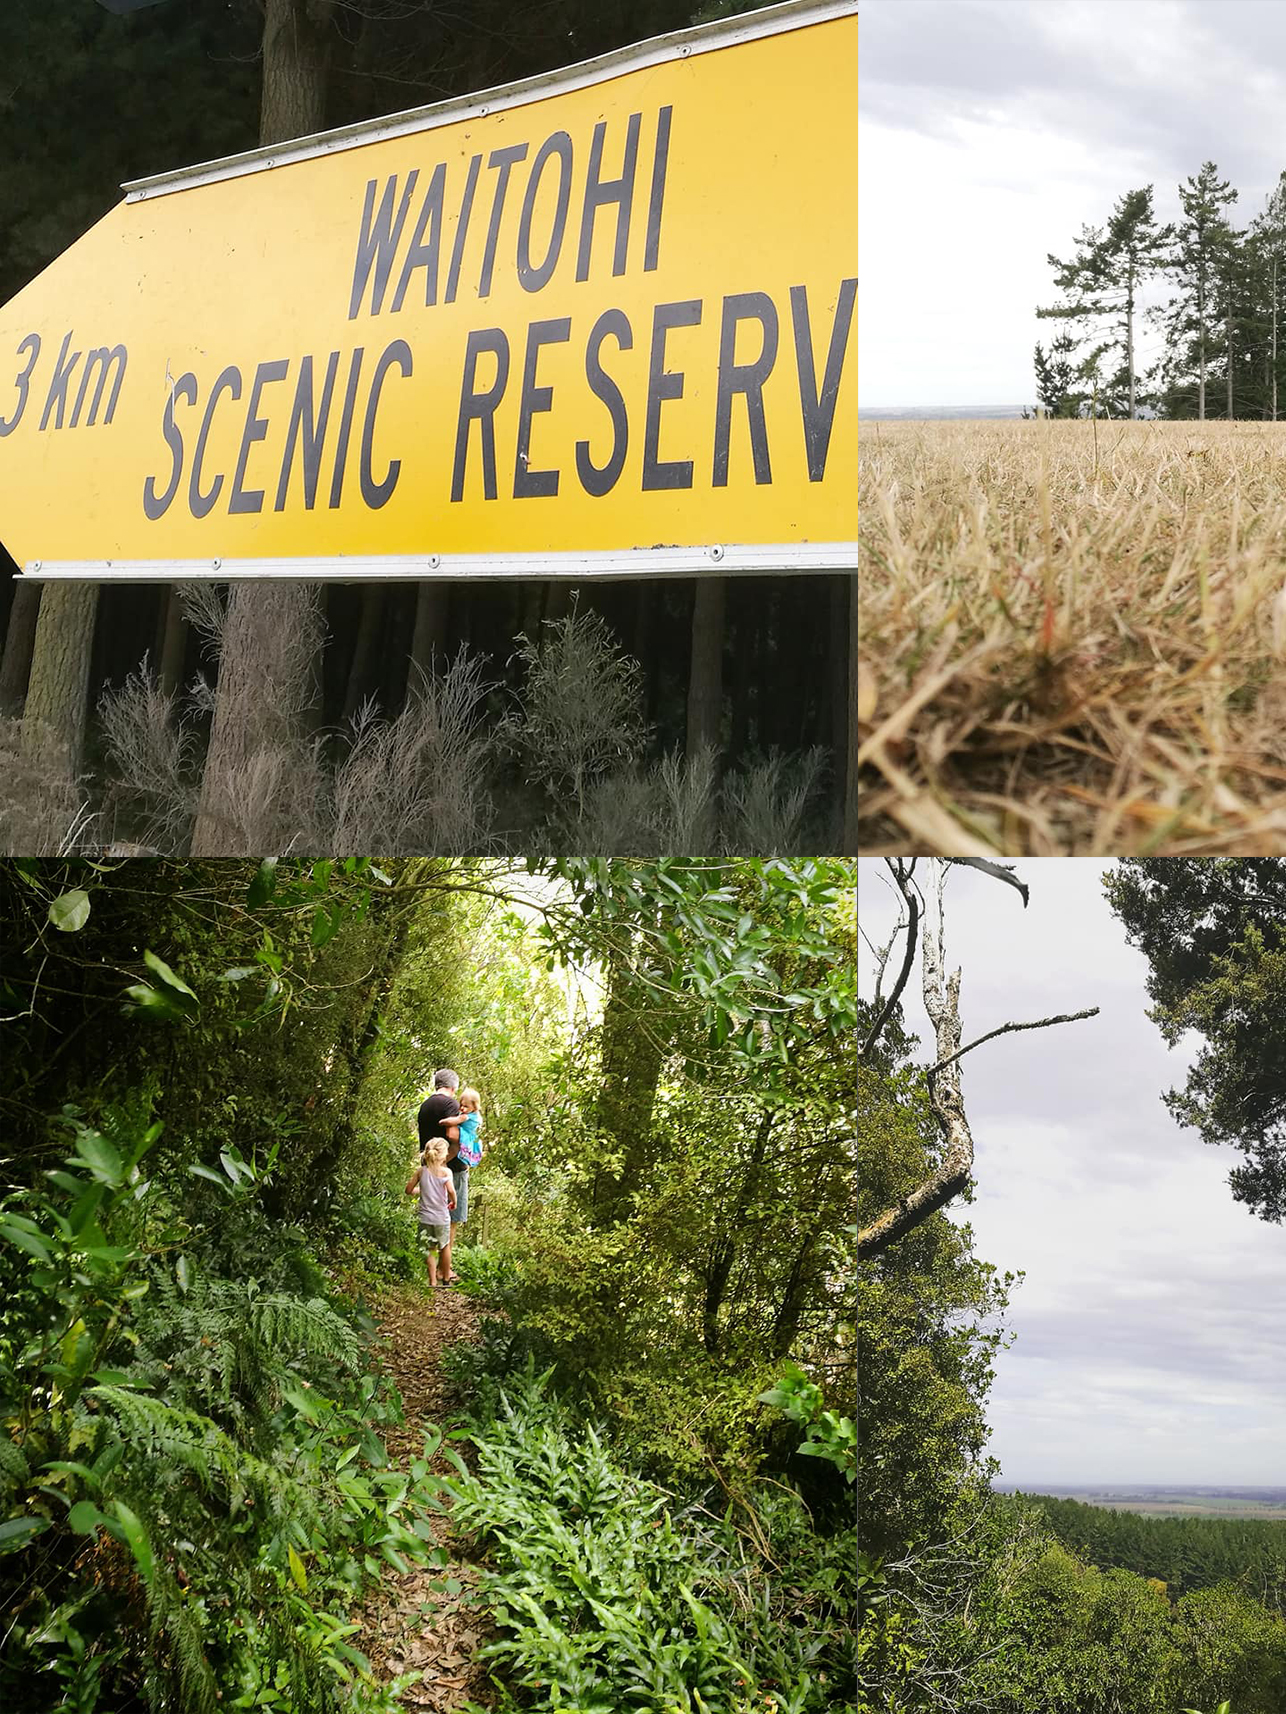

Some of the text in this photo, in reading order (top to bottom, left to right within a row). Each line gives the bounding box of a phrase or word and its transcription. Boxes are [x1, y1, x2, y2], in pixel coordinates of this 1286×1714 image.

[348, 104, 674, 320] WAITOHI
[0, 330, 128, 438] 3 km
[143, 278, 858, 521] SCENIC RESERV
